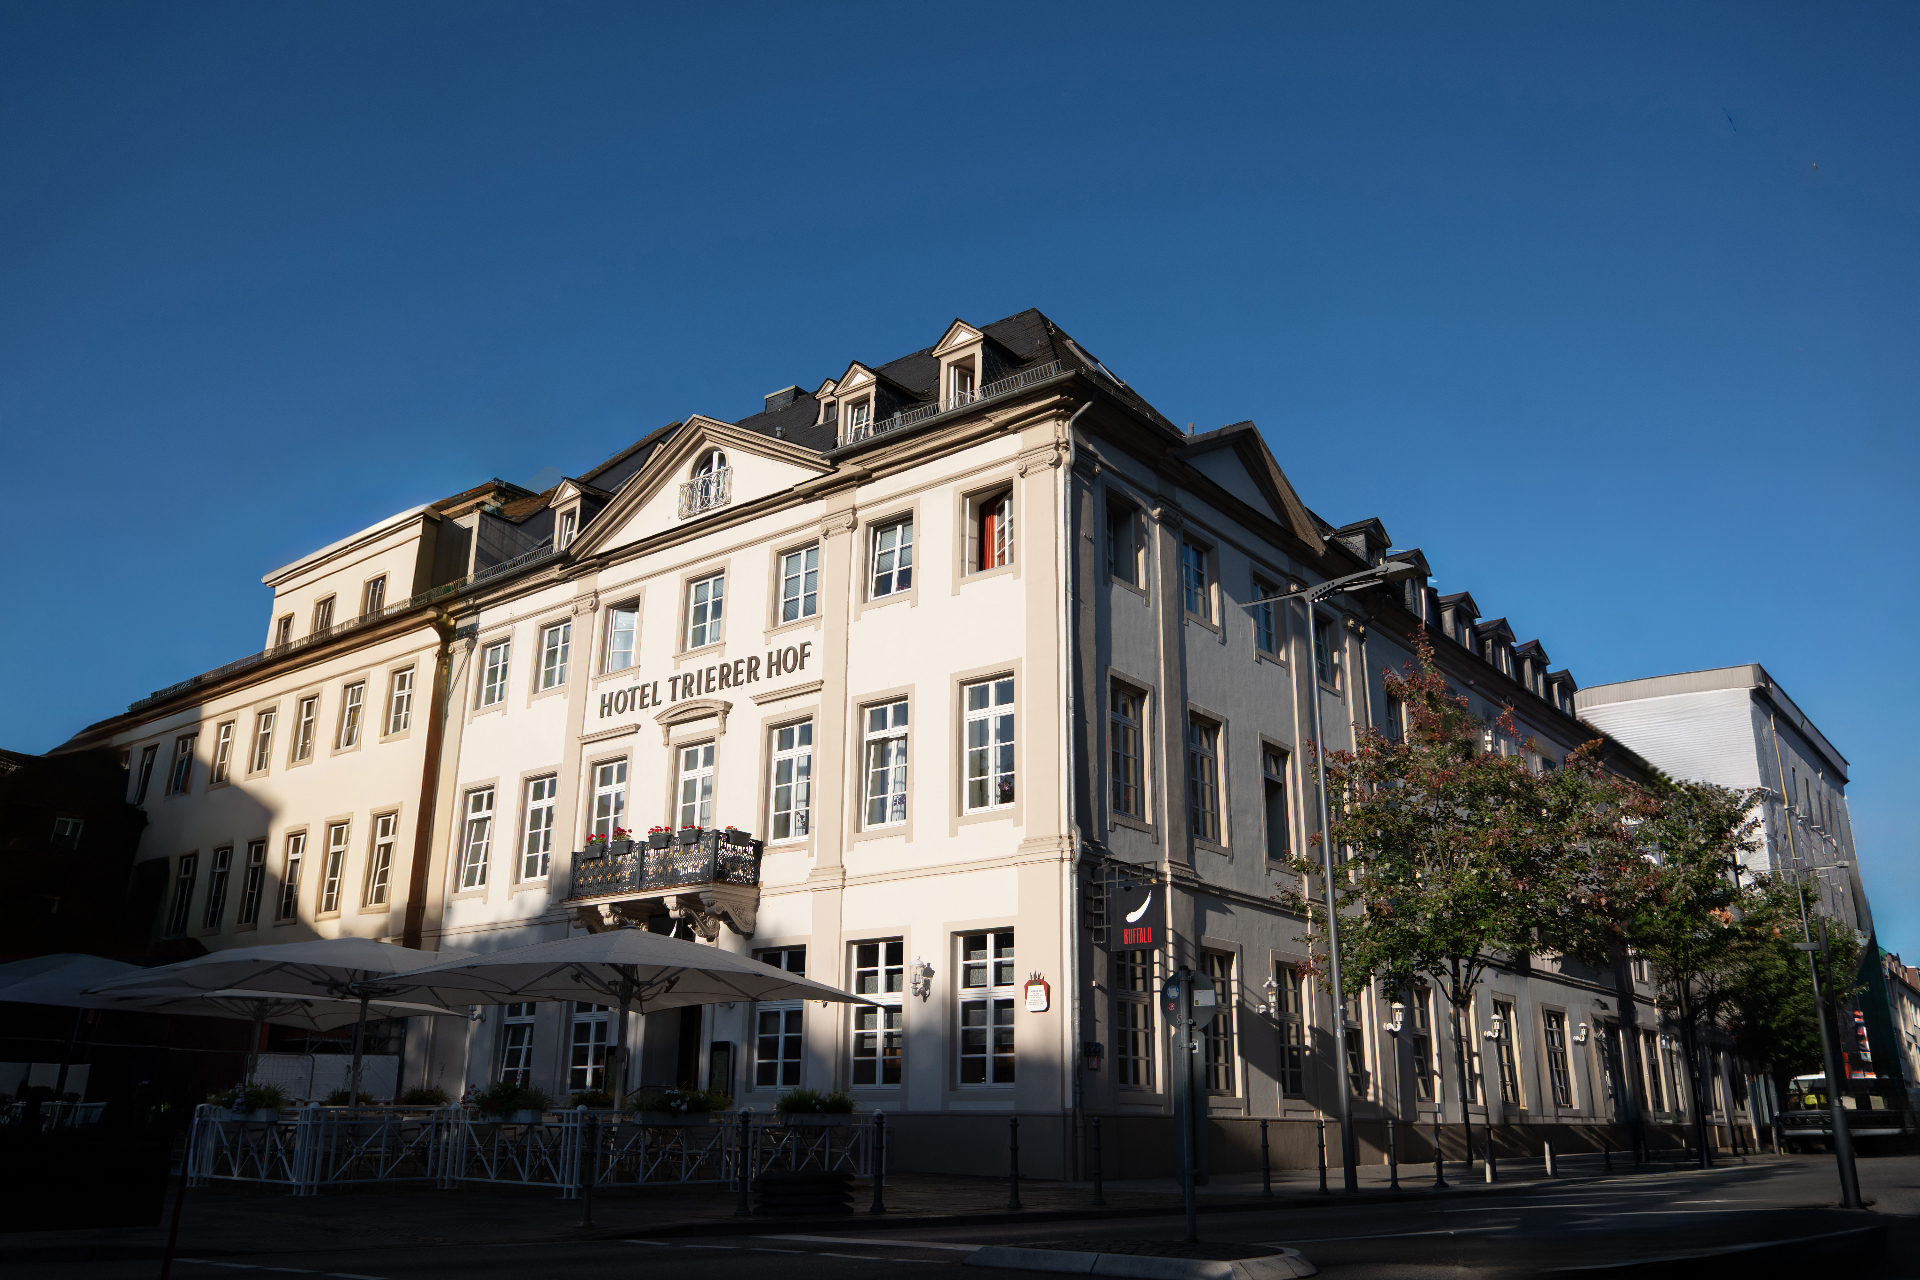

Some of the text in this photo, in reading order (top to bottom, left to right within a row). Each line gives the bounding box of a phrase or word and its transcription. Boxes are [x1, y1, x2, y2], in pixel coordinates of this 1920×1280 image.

[599, 641, 812, 718] HOTEL TRIERER HOF
[1124, 927, 1152, 944] BUFFALO
